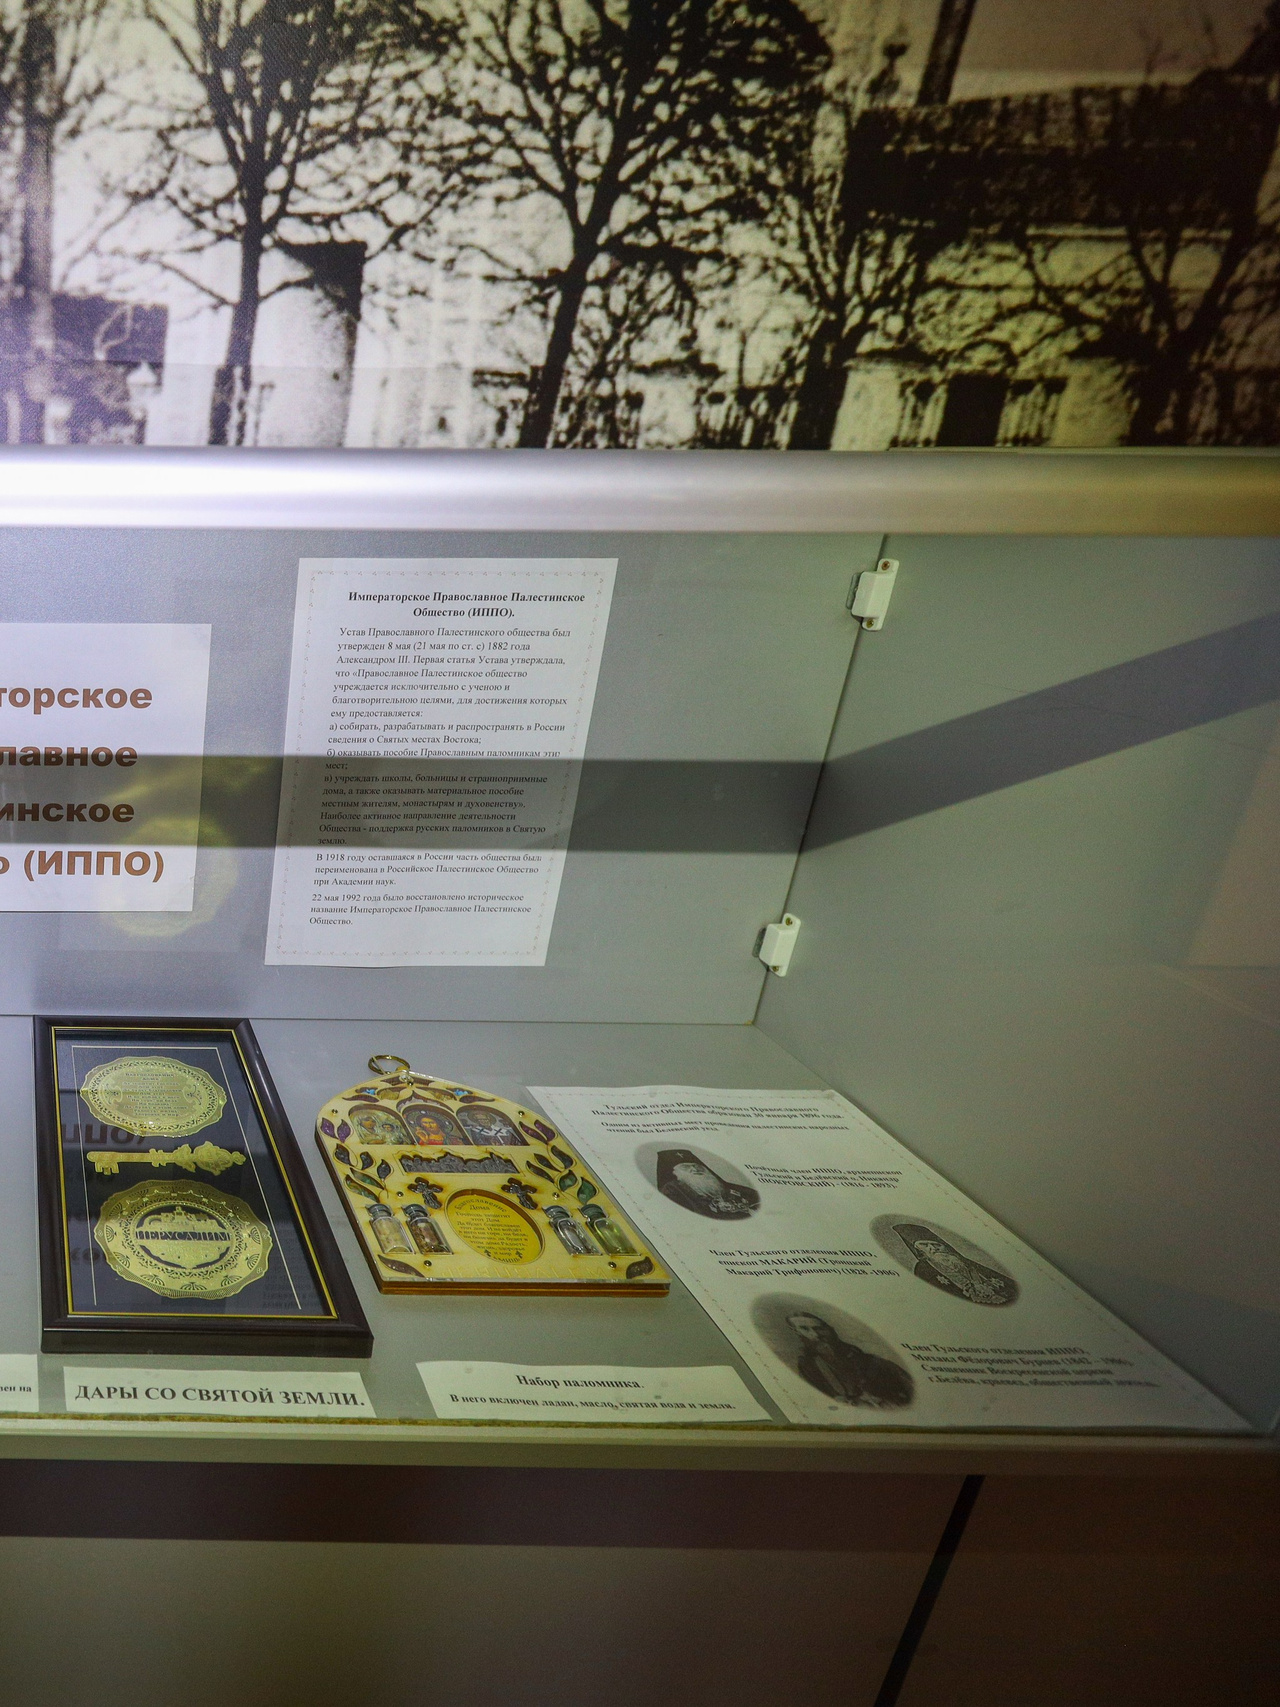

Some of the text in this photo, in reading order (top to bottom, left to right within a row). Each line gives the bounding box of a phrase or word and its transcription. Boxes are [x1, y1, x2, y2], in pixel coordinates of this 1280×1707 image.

[348, 591, 585, 604] Императорское Православное Палестинское
[412, 606, 516, 618] Общество (ИППО).
[339, 626, 571, 638] Устав Православного Палестинского общества был
[336, 642, 385, 652] утвержден
[386, 640, 393, 650] 8
[412, 640, 426, 652] (21
[487, 641, 508, 650] 1882
[509, 643, 530, 651] года
[335, 655, 396, 666] Александром
[397, 654, 410, 663] III.
[412, 654, 445, 665] Первая
[478, 654, 508, 664] Устава
[509, 657, 565, 666] утверждала,
[351, 668, 419, 679] «Православное
[420, 668, 483, 677] Палестинское
[484, 668, 527, 678] общество
[332, 684, 388, 692] учреждается
[467, 684, 502, 692] ученою
[332, 697, 418, 707] благотворительною
[473, 697, 527, 705] достижения
[528, 697, 567, 707] которых
[330, 708, 423, 719] ему предоставляется:
[338, 721, 381, 732] собирать,
[382, 721, 445, 732] разрабатывать
[454, 723, 524, 733] распространять
[533, 722, 565, 731] России
[327, 734, 367, 745] сведения
[376, 734, 409, 743] Святых
[410, 736, 441, 744] местах
[442, 734, 481, 744] Востока;
[23, 849, 164, 882] (ИППО)
[314, 866, 378, 875] переименована
[386, 864, 434, 873] Российское
[435, 864, 494, 873] Палестинское
[496, 865, 539, 874] Общество
[312, 877, 397, 887] при Академии наук.
[311, 893, 322, 901] 22
[341, 893, 361, 901] 1992
[362, 895, 381, 903] года
[382, 893, 404, 901] было
[467, 894, 524, 902] историческое
[349, 905, 413, 915] Императорское
[413, 904, 472, 914] Православное
[473, 904, 531, 912] Палестинское
[308, 916, 353, 925] Общество.
[515, 1374, 644, 1389] Набор паломника.
[74, 1384, 368, 1406] ДАРЫ СО СВЯТОЙ ЗЕМЛИ.
[488, 1396, 539, 1406] включен
[541, 1400, 578, 1408] ладан,
[578, 1400, 618, 1409] масло,
